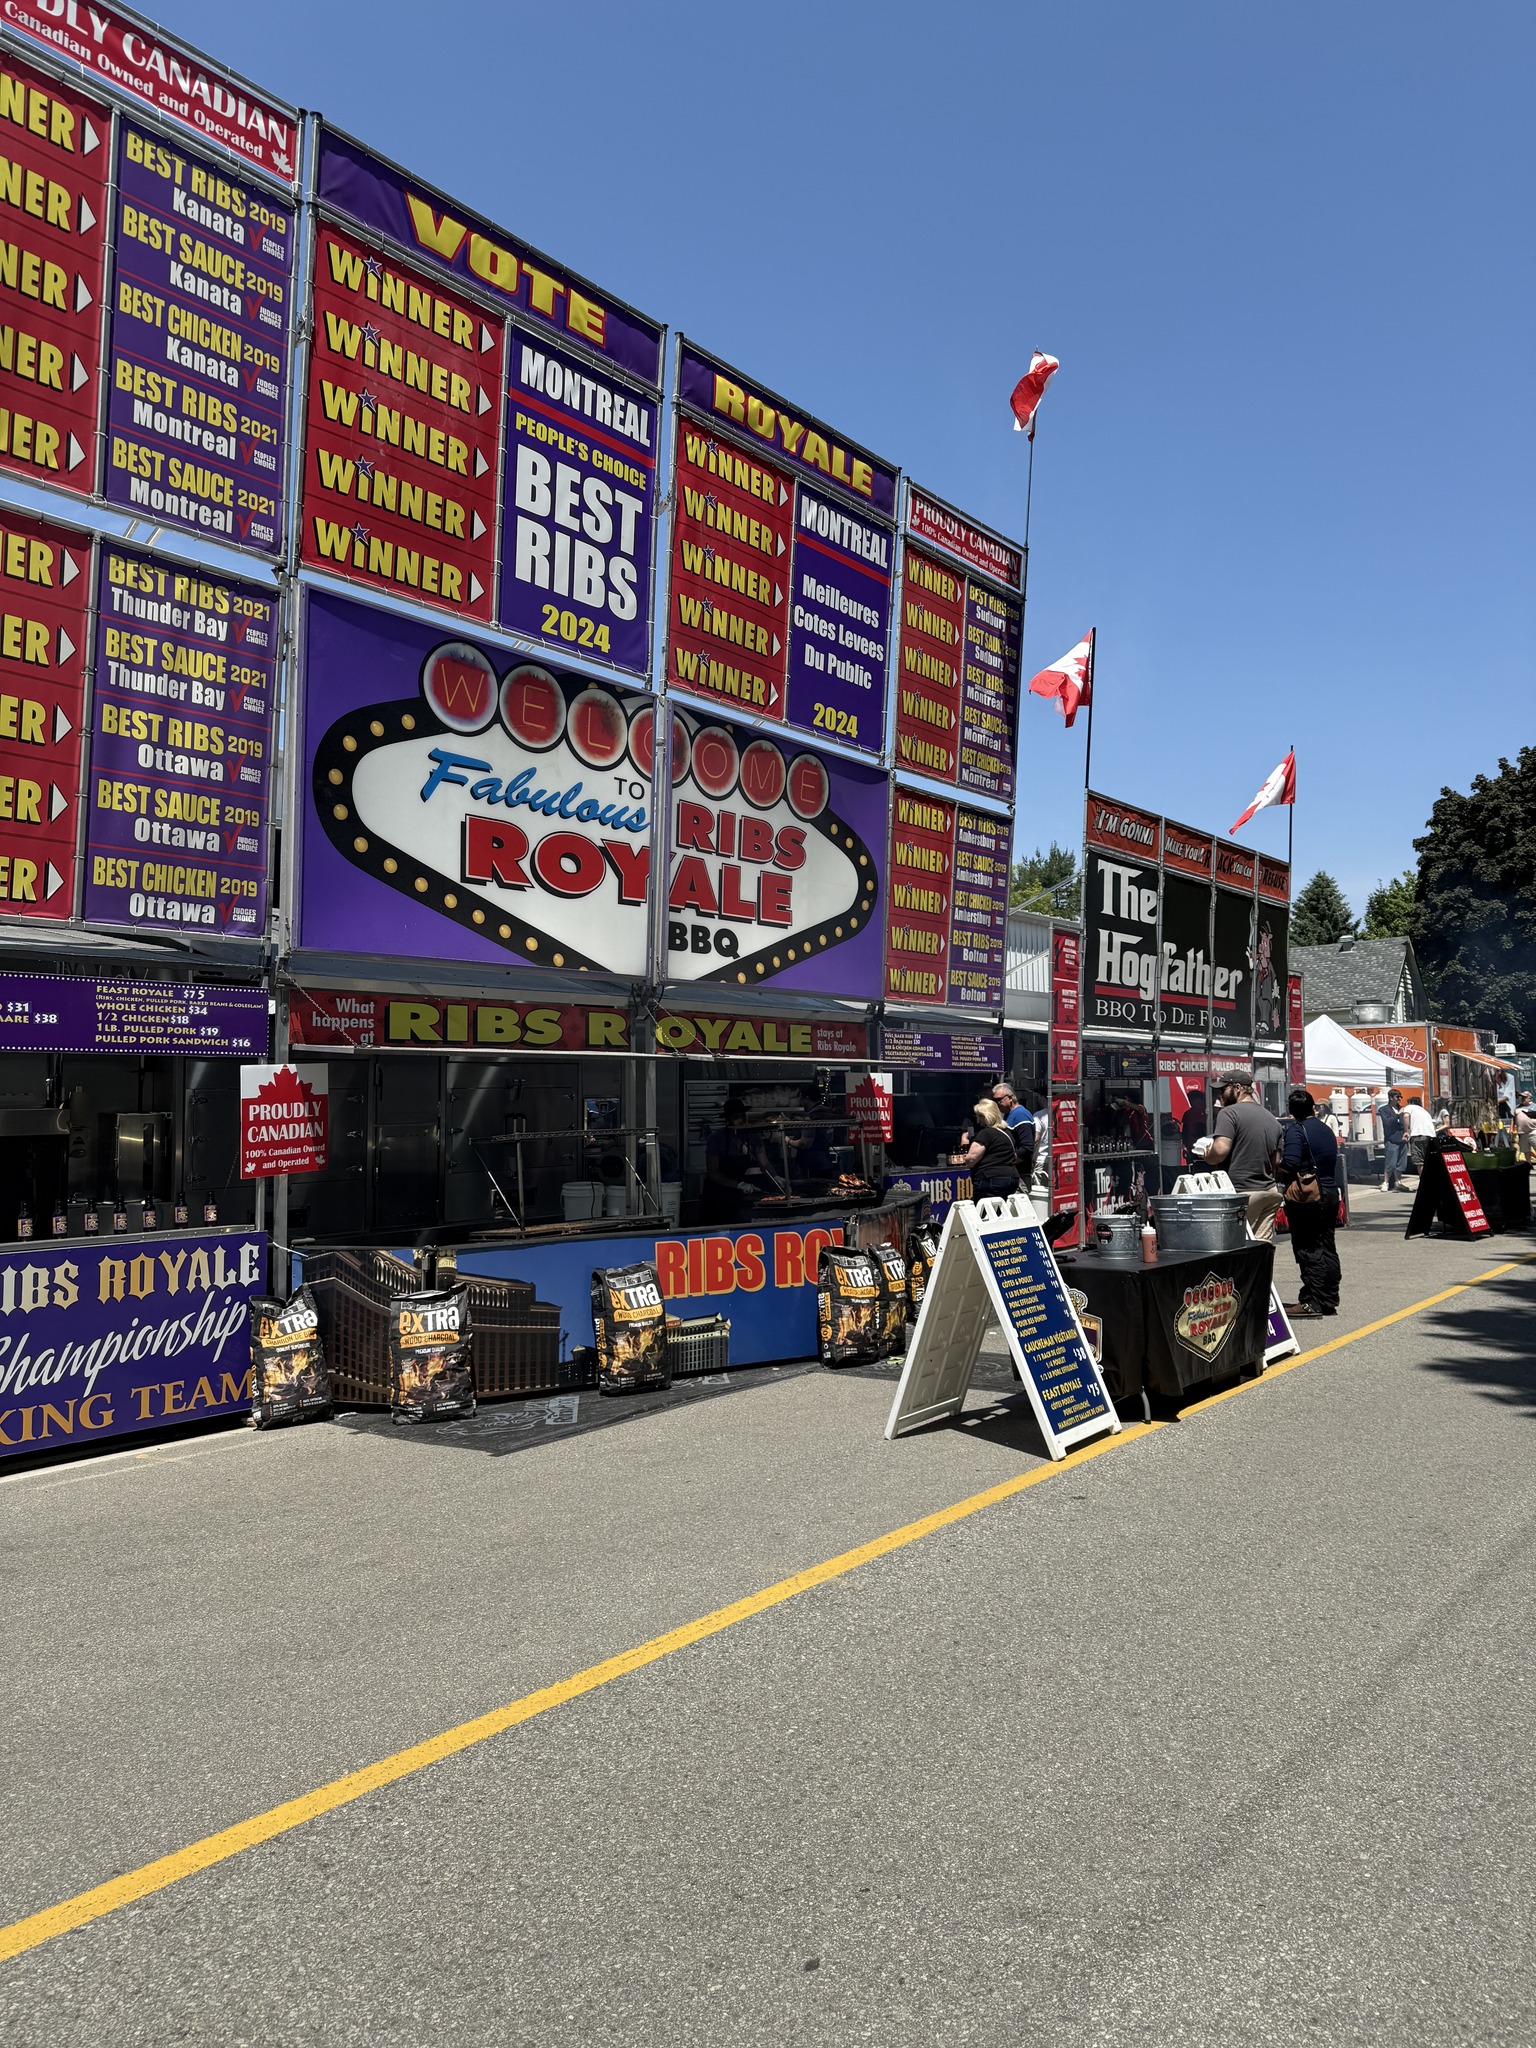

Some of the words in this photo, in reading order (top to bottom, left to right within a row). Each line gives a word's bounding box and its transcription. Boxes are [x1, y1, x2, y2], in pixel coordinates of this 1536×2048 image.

[4, 1, 92, 62] Canadian
[97, 51, 154, 97] Owned
[159, 88, 189, 117] and
[194, 109, 263, 158] Operated
[122, 32, 288, 151] CANADIAN
[127, 130, 186, 185] BEST
[191, 165, 246, 218] RIBS
[249, 202, 286, 235] 2019
[173, 187, 245, 245] Kanata
[406, 192, 606, 349] VOTE
[119, 281, 165, 328] BEST
[167, 303, 242, 362] CHICKEN
[244, 344, 280, 374] 2019
[166, 335, 239, 388] Kanata
[116, 358, 177, 408] BEST
[182, 385, 237, 433] RIBS
[240, 415, 277, 445] 2021
[520, 345, 651, 448] MONTREAL
[133, 398, 236, 460] Montreal
[515, 411, 590, 463] PEOPLE'S
[592, 449, 647, 492] CHOICE
[713, 373, 873, 497] ROYALE
[515, 444, 643, 556] BEST
[801, 494, 888, 569] MONTREAL
[915, 496, 967, 543] PROUDLY
[969, 530, 1019, 573] CANADIAN
[109, 553, 169, 597] BEST
[174, 574, 229, 615] RIBS
[232, 596, 270, 622] 2021
[515, 515, 638, 621] RIBS
[111, 586, 190, 630] Thunder
[194, 610, 228, 642] Bay
[802, 574, 880, 629] Meilleures
[541, 604, 611, 654] 2024
[793, 605, 836, 641] Cotes
[838, 623, 884, 662] Levees
[804, 643, 825, 672] Du
[827, 653, 873, 690] Public
[102, 703, 163, 742] BEST
[168, 718, 224, 755] RIBS
[228, 736, 262, 759] 2019
[813, 703, 859, 739] 2024
[138, 744, 224, 782] Ottawa
[421, 747, 651, 833] Fabulous
[613, 777, 646, 801] TO
[676, 799, 808, 872] RIBS
[1120, 818, 1154, 846] GONNA
[93, 855, 139, 889] BEST
[142, 862, 216, 898] CHICKEN
[221, 877, 257, 897] 2019
[460, 814, 795, 928] ROYALE
[1097, 858, 1158, 925] The
[129, 892, 215, 924] Ottawa
[669, 921, 742, 960] BBQ
[952, 929, 972, 946] BEST
[962, 948, 988, 964] Bolton
[950, 969, 967, 986] BEST
[1096, 928, 1243, 1001] Hogfather
[7, 1002, 29, 1012] $31
[96, 985, 130, 995] FEAST
[132, 987, 174, 998] ROYALE
[96, 1002, 137, 1012] WHOLE
[139, 1004, 186, 1014] CHICKEN
[188, 1005, 208, 1016] $34
[335, 998, 375, 1014] What
[961, 987, 986, 1002] Bolton
[1095, 999, 1136, 1023] BBQ
[34, 1013, 58, 1024] $38
[96, 1012, 118, 1022] 1/2
[121, 1014, 169, 1024] CHICKEN
[170, 1015, 189, 1025] $18
[123, 1025, 164, 1034] PULLED
[166, 1026, 197, 1035] PORK
[200, 1026, 219, 1037] $19
[312, 1011, 375, 1035] happens
[360, 1031, 374, 1044] at
[384, 1001, 563, 1046] RIBS
[816, 1028, 834, 1039] stays
[835, 1029, 843, 1038] at
[95, 1035, 137, 1044] PULLED
[139, 1036, 170, 1045] PORK
[172, 1036, 229, 1046] SANDWICH
[232, 1037, 251, 1048] $16
[817, 1040, 832, 1051] Ribs
[833, 1041, 857, 1053] Royale
[1158, 1060, 1175, 1072] RIBS
[1179, 1061, 1208, 1072] CHICKEN
[1211, 1061, 1234, 1071] PULLED
[249, 1101, 321, 1121] PROUDLY
[850, 1097, 889, 1108] PROUDLY
[245, 1149, 267, 1159] 100%
[268, 1146, 301, 1156] Canadian
[303, 1144, 325, 1153] Owned
[247, 1121, 324, 1143] CANADIAN
[262, 1159, 276, 1169] and
[278, 1156, 310, 1168] Operated
[97, 1241, 260, 1304] ROYALE
[655, 1233, 767, 1300] RIBS
[131, 1369, 253, 1420] TEAM
[1042, 1385, 1061, 1401] FEAST
[1060, 1378, 1082, 1394] ROYALE
